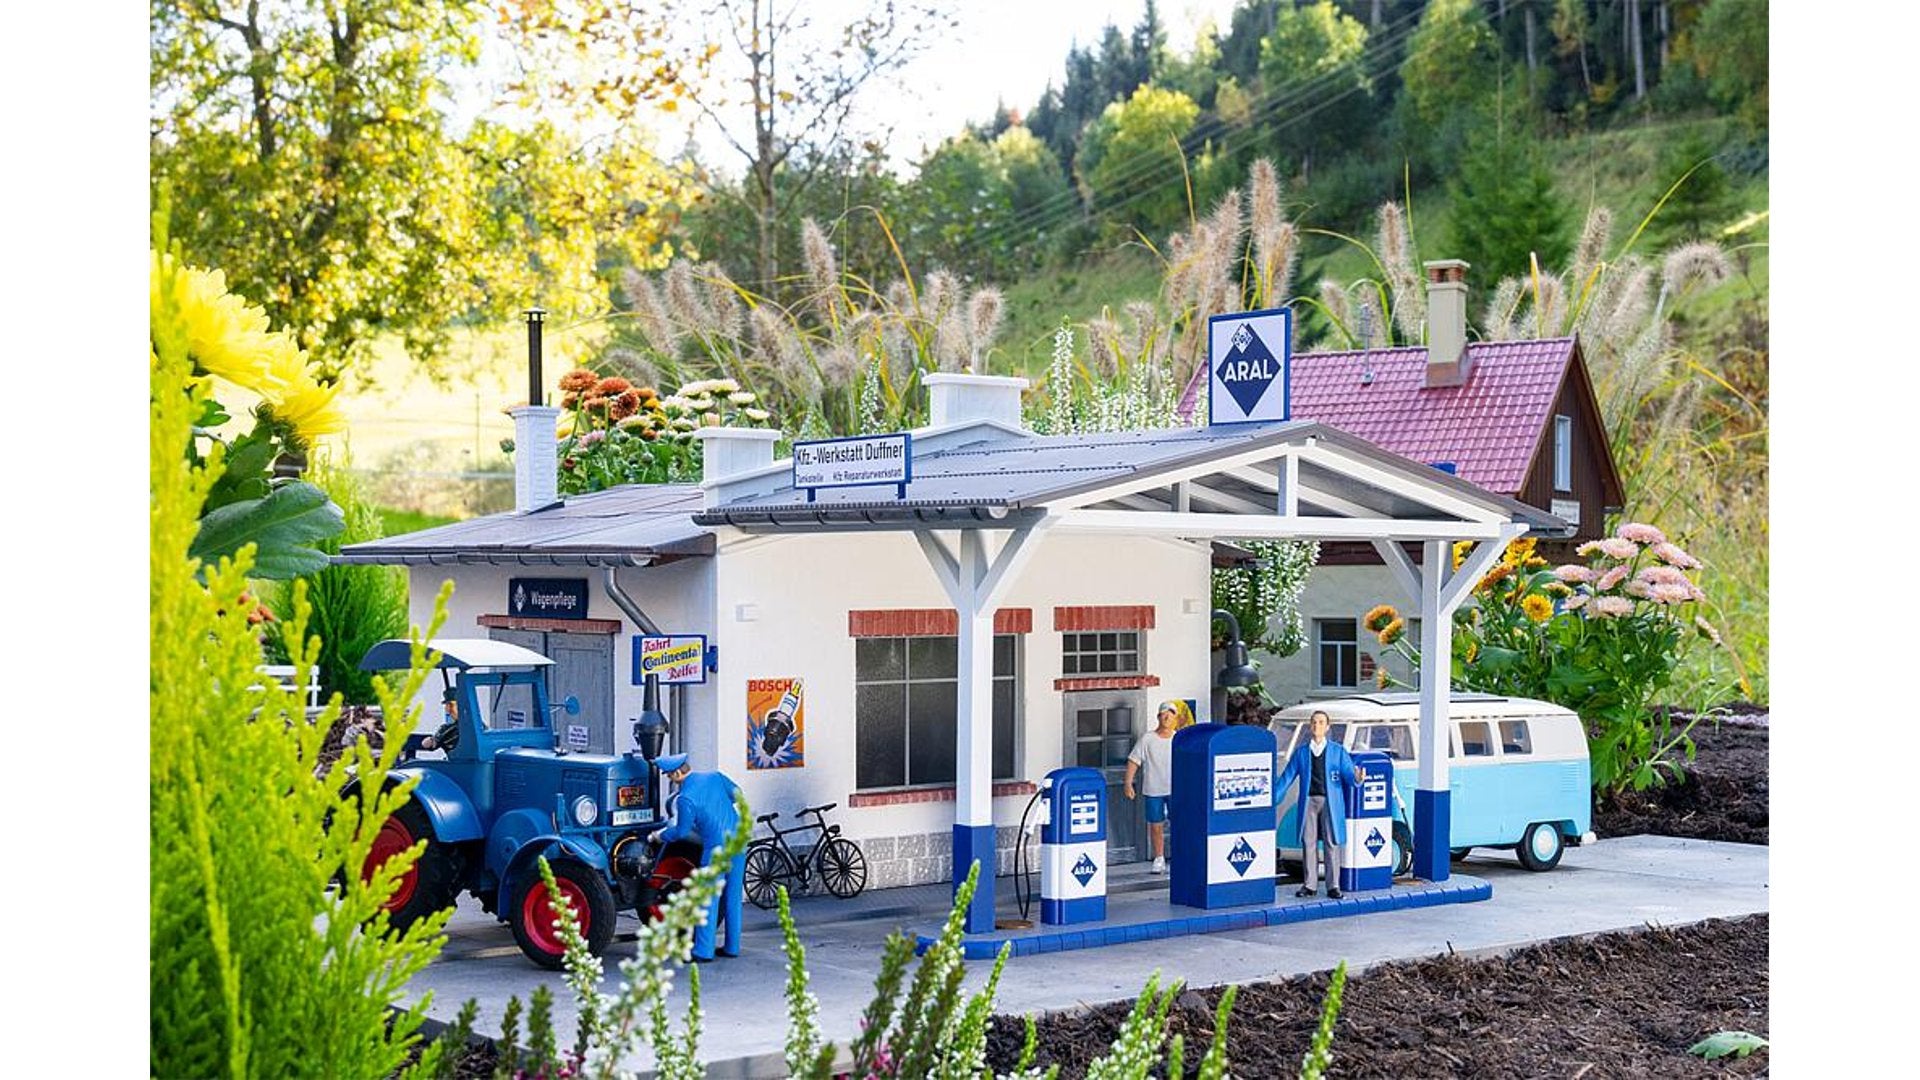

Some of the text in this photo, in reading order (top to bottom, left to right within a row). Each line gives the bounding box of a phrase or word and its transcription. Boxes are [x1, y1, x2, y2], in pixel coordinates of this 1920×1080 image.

[1223, 359, 1273, 382] ARAL
[797, 442, 903, 465] Kfz.-Werkstatt Duffner
[530, 590, 577, 609] Wagenpflege
[748, 679, 792, 692] BOSCH
[1230, 851, 1254, 863] ARAL
[1074, 865, 1095, 876] ARAL
